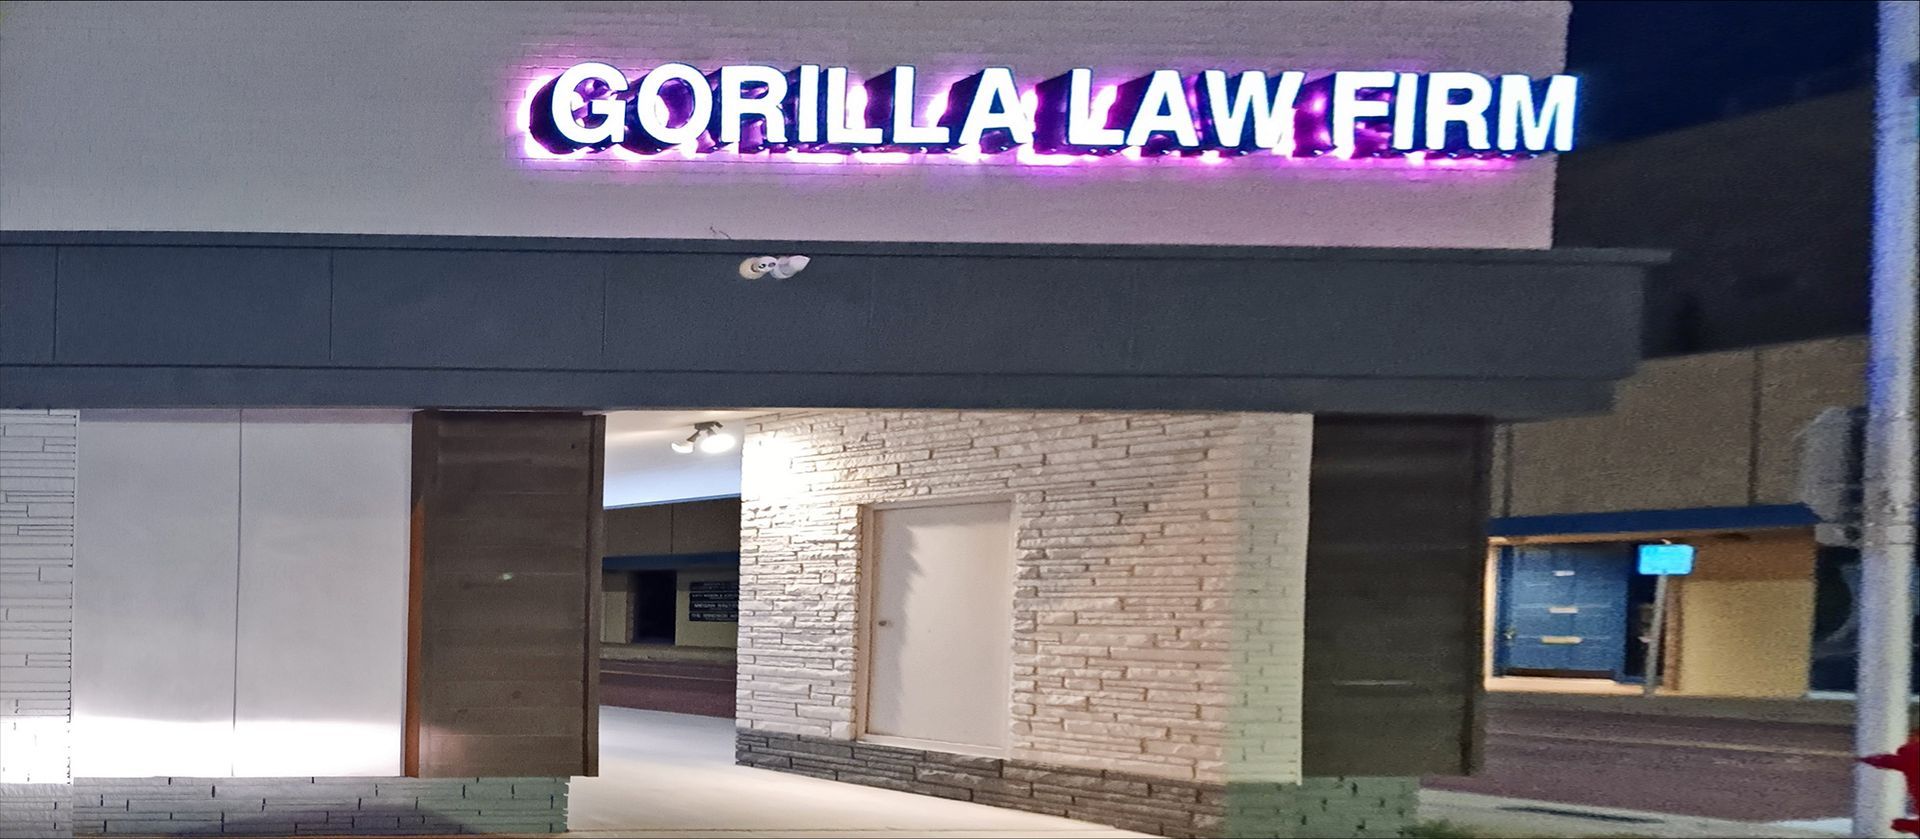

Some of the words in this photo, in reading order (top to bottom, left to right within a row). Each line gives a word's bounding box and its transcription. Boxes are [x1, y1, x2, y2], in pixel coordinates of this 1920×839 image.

[550, 61, 1034, 146] GORILLA
[1067, 67, 1306, 148] LAW
[1331, 70, 1580, 152] FIRM
